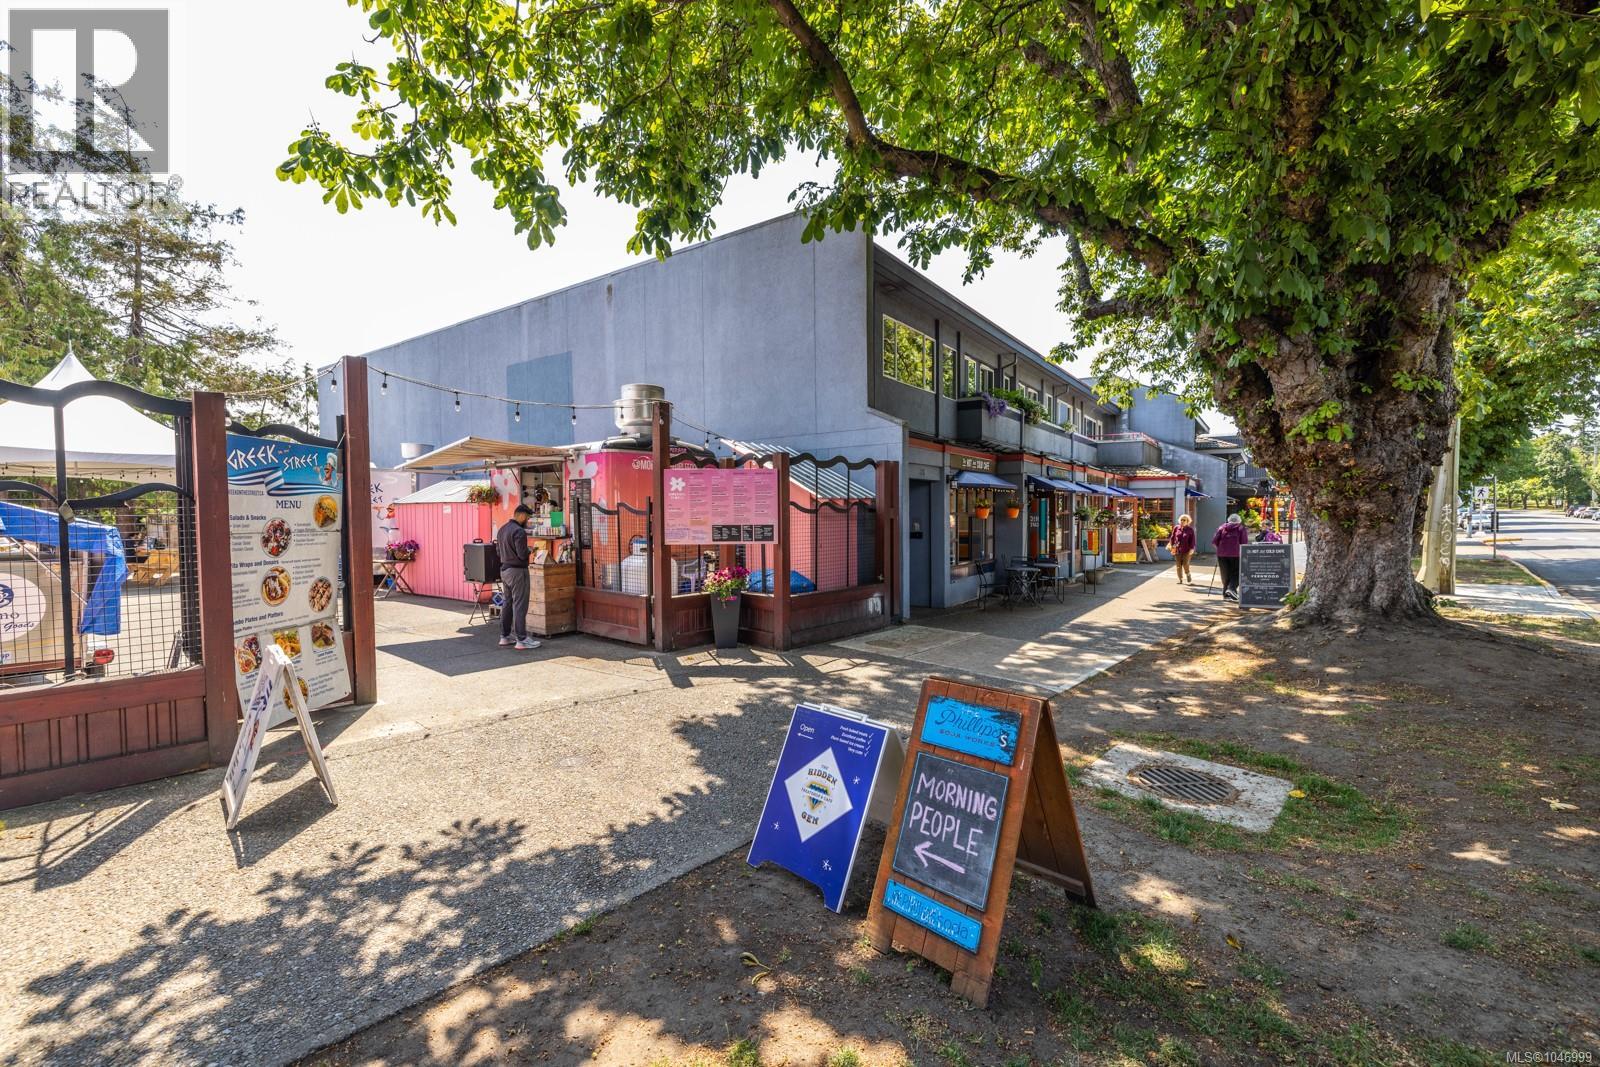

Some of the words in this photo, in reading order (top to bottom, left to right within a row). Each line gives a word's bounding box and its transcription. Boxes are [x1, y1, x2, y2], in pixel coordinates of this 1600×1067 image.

[227, 444, 278, 470] GREEK
[283, 453, 318, 471] STREET
[276, 500, 302, 509] MENU
[800, 724, 815, 734] Open
[808, 768, 838, 786] HIDDEN
[916, 772, 998, 822] MORNING
[909, 802, 984, 856] PEOPLE
